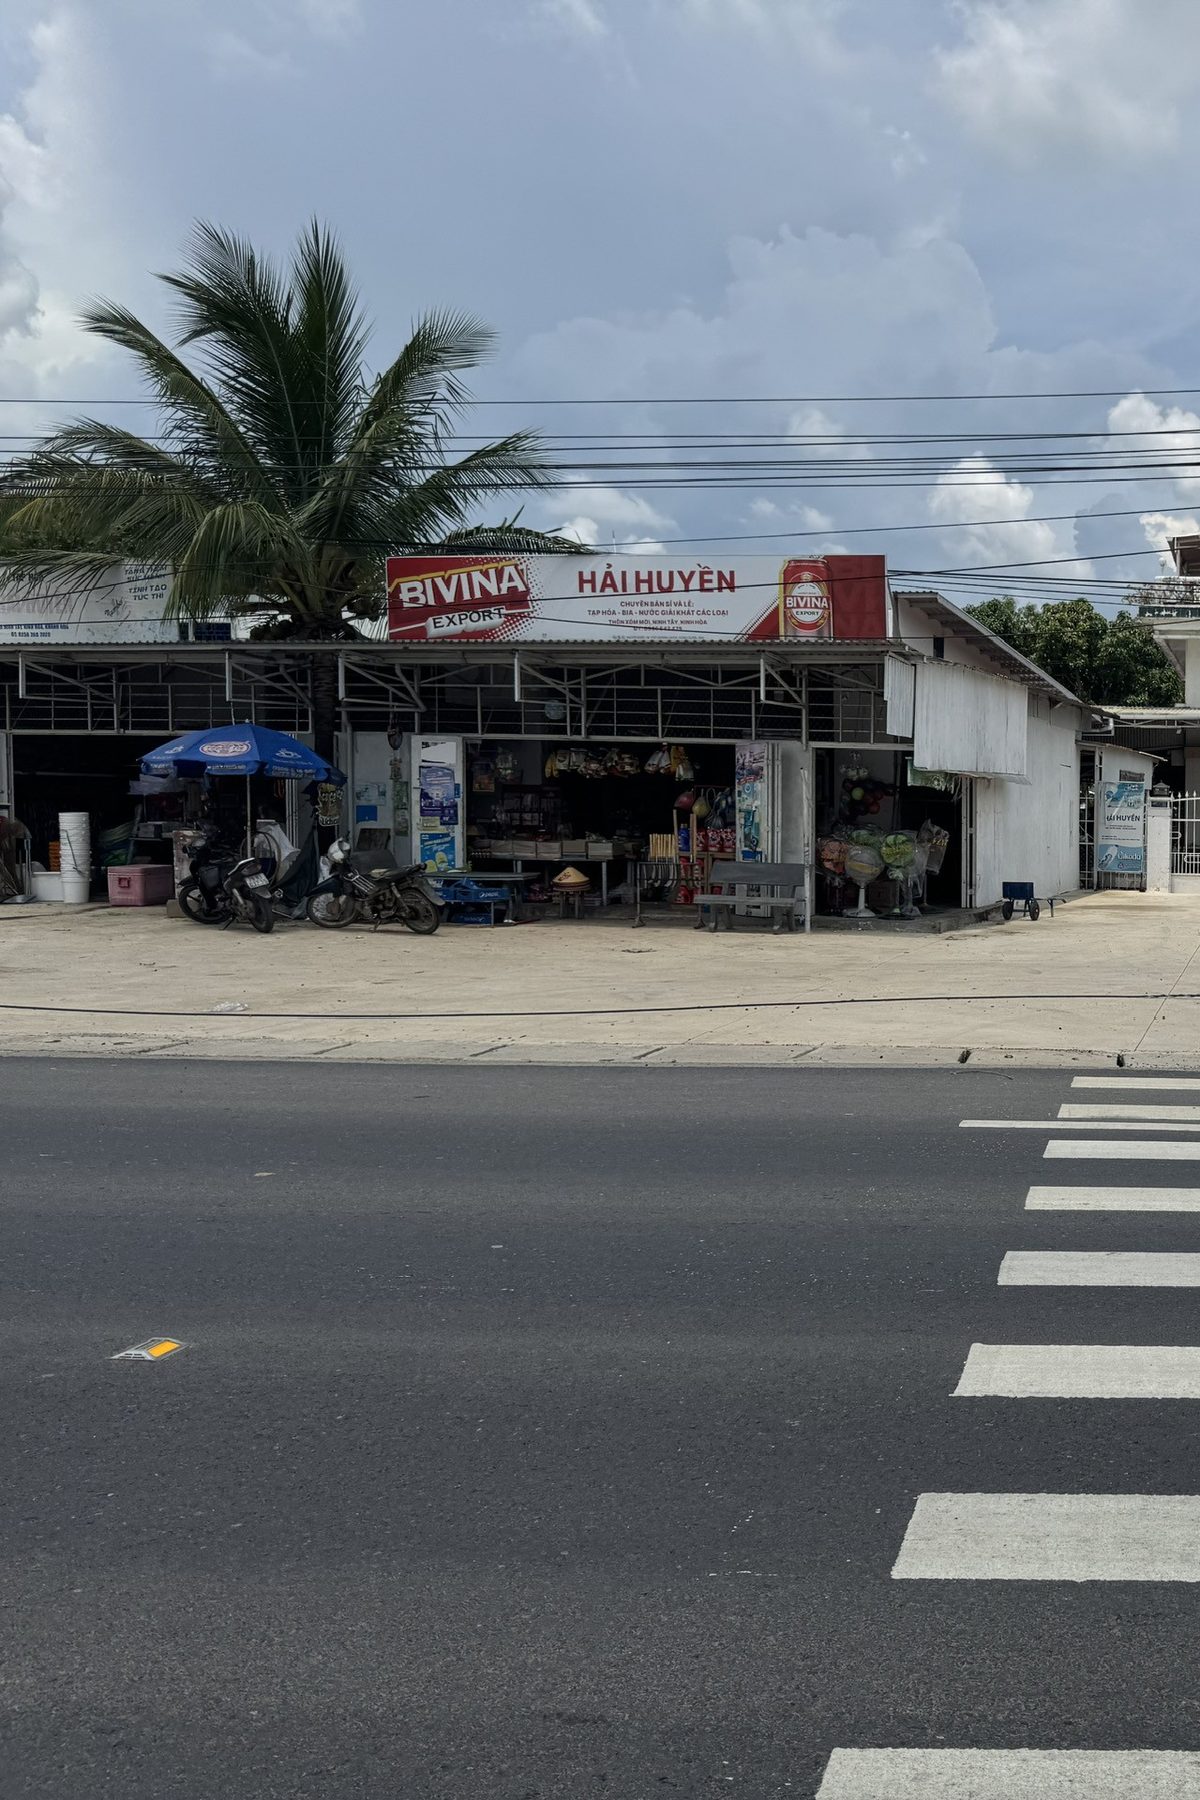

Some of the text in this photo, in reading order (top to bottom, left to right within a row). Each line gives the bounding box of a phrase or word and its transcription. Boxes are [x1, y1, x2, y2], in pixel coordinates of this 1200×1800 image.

[399, 565, 527, 608] BIVINA
[578, 563, 735, 593] HẢI HUYỀN
[786, 597, 828, 608] BIVINA
[432, 607, 505, 629] EXPORT
